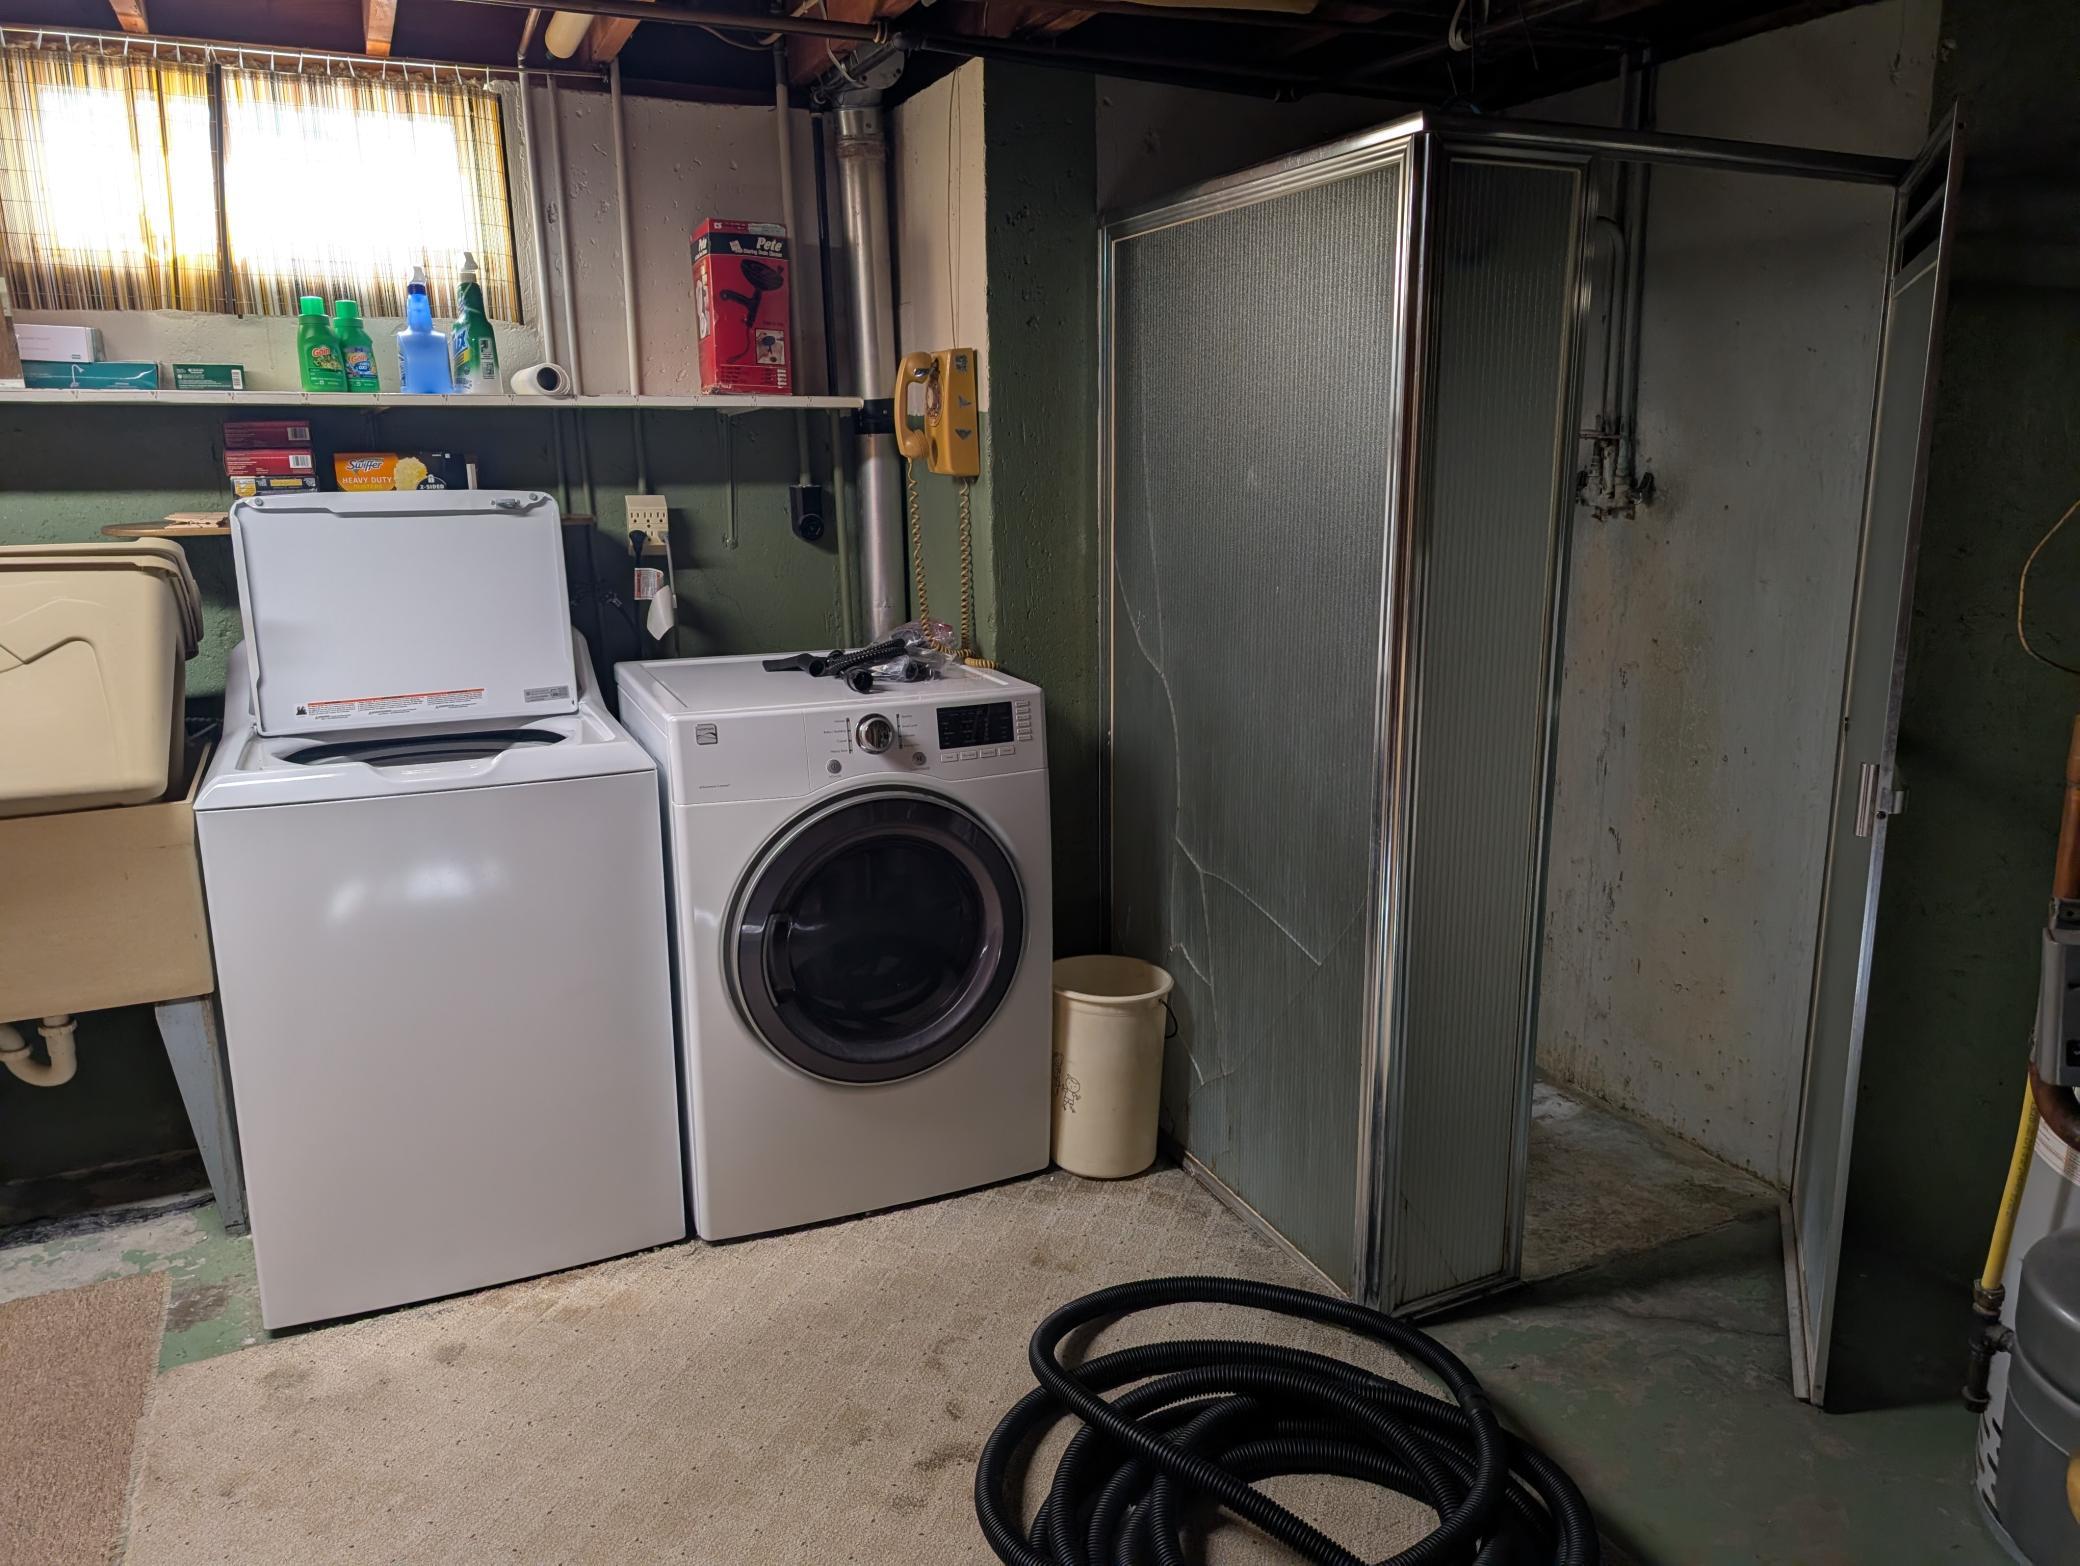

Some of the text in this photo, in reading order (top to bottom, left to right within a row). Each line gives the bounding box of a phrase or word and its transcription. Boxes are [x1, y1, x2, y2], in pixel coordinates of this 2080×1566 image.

[756, 237, 783, 252] Pete
[312, 347, 331, 357] Gain
[349, 353, 369, 364] Gain
[347, 457, 384, 472] Swiffer
[342, 476, 393, 484] HEAVY DUTY
